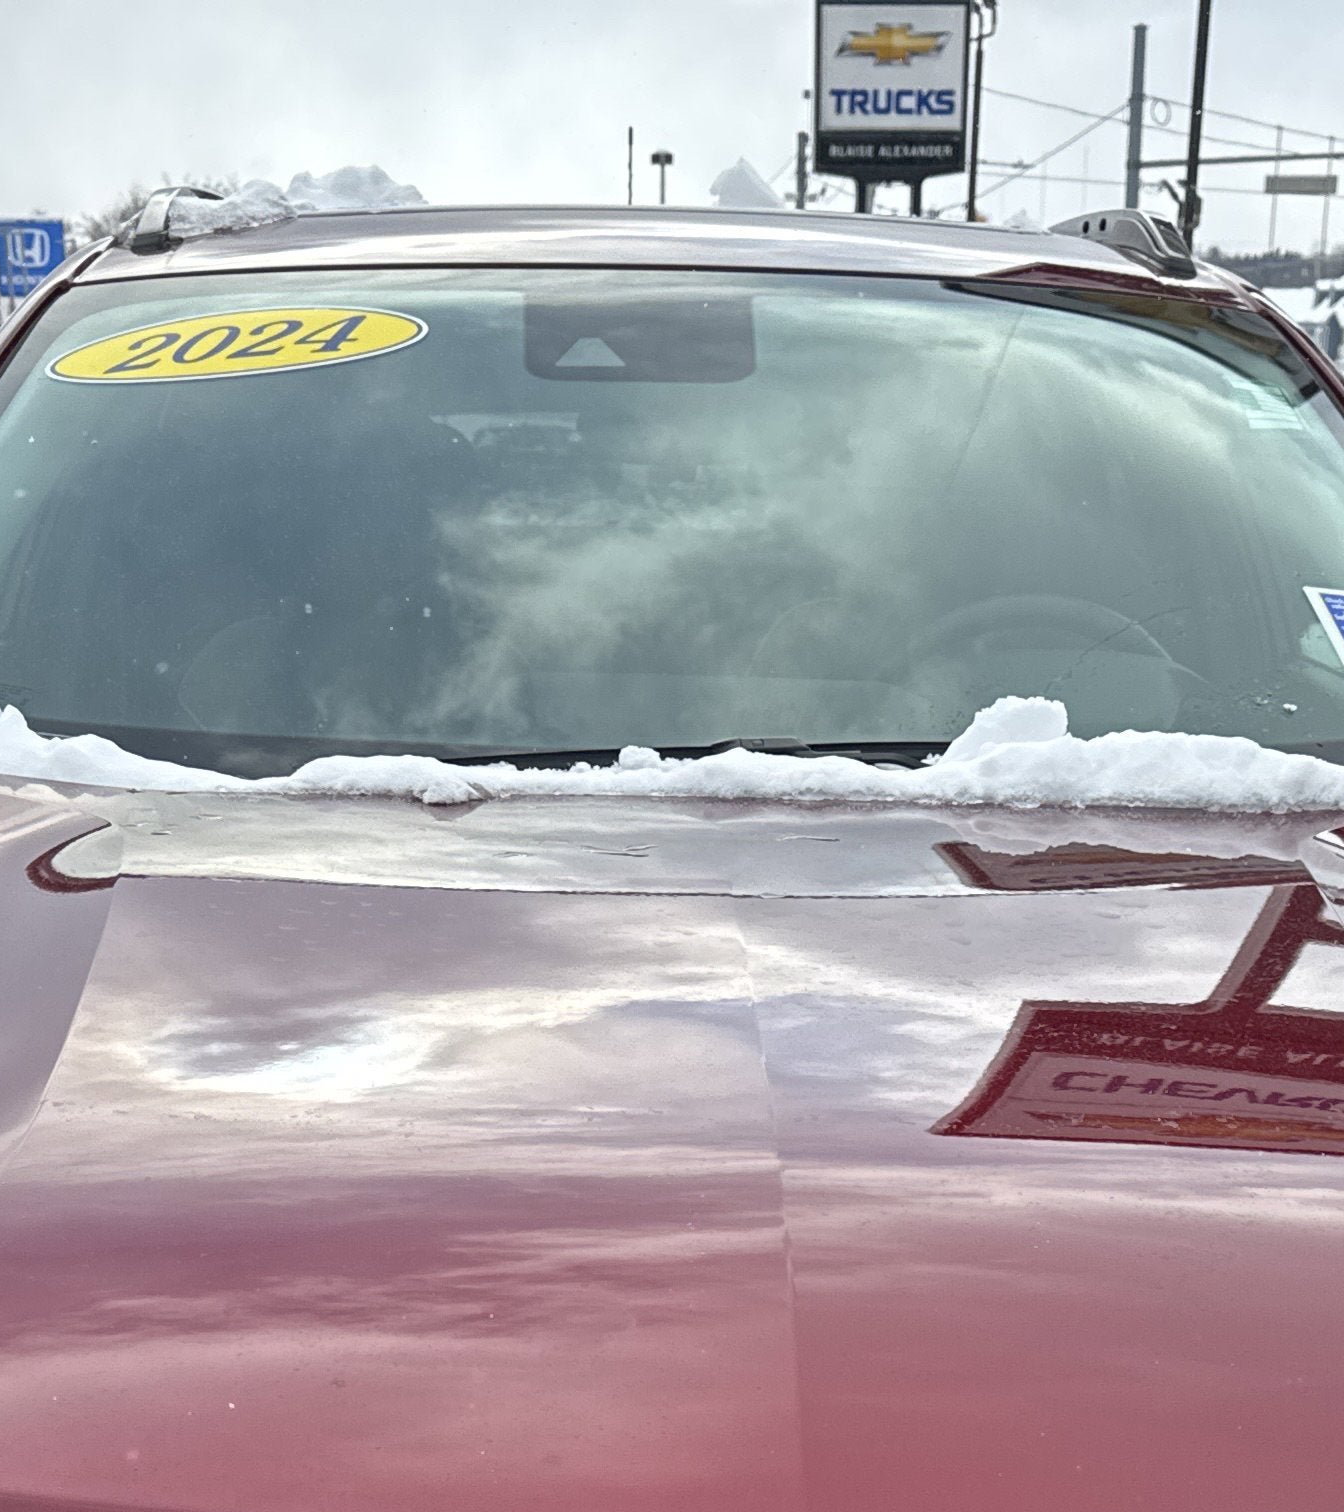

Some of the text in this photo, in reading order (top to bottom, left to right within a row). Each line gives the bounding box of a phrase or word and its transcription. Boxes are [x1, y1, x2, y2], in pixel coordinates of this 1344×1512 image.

[830, 89, 956, 115] TRUCKS
[828, 144, 954, 158] BLAISE ALEXANDER
[103, 314, 368, 376] 2024
